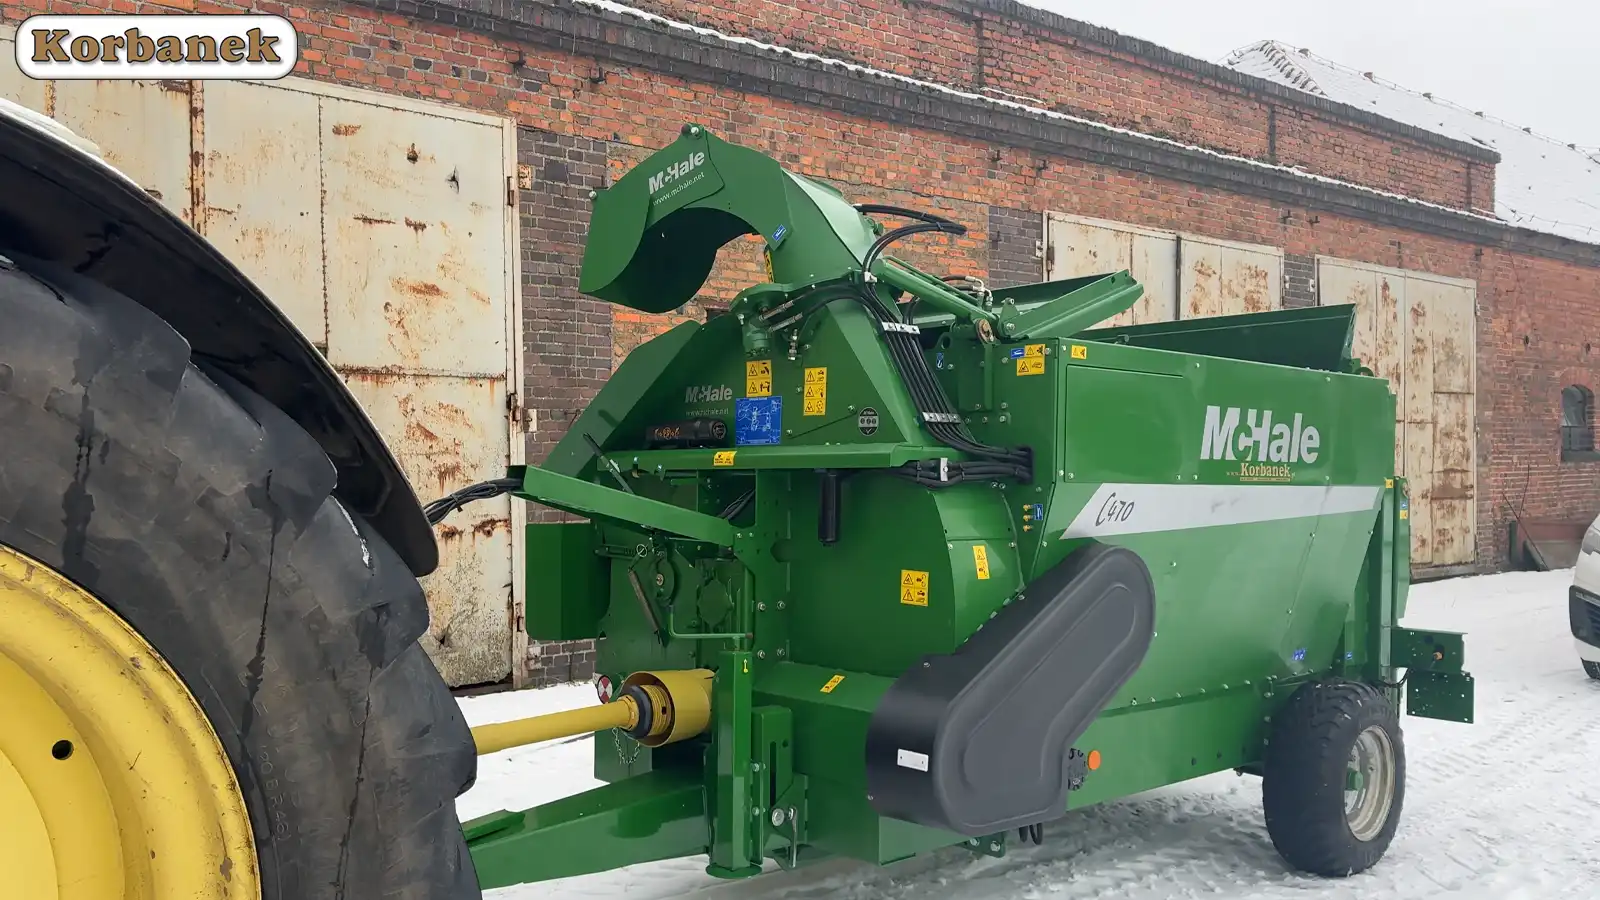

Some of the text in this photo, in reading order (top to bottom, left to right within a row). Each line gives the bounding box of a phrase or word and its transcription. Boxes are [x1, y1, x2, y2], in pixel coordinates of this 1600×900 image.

[648, 151, 706, 195] McHale
[652, 171, 706, 206] www.mchale.net
[684, 384, 733, 404] McHale
[1200, 405, 1320, 464] McHale
[1095, 491, 1135, 527] C470
